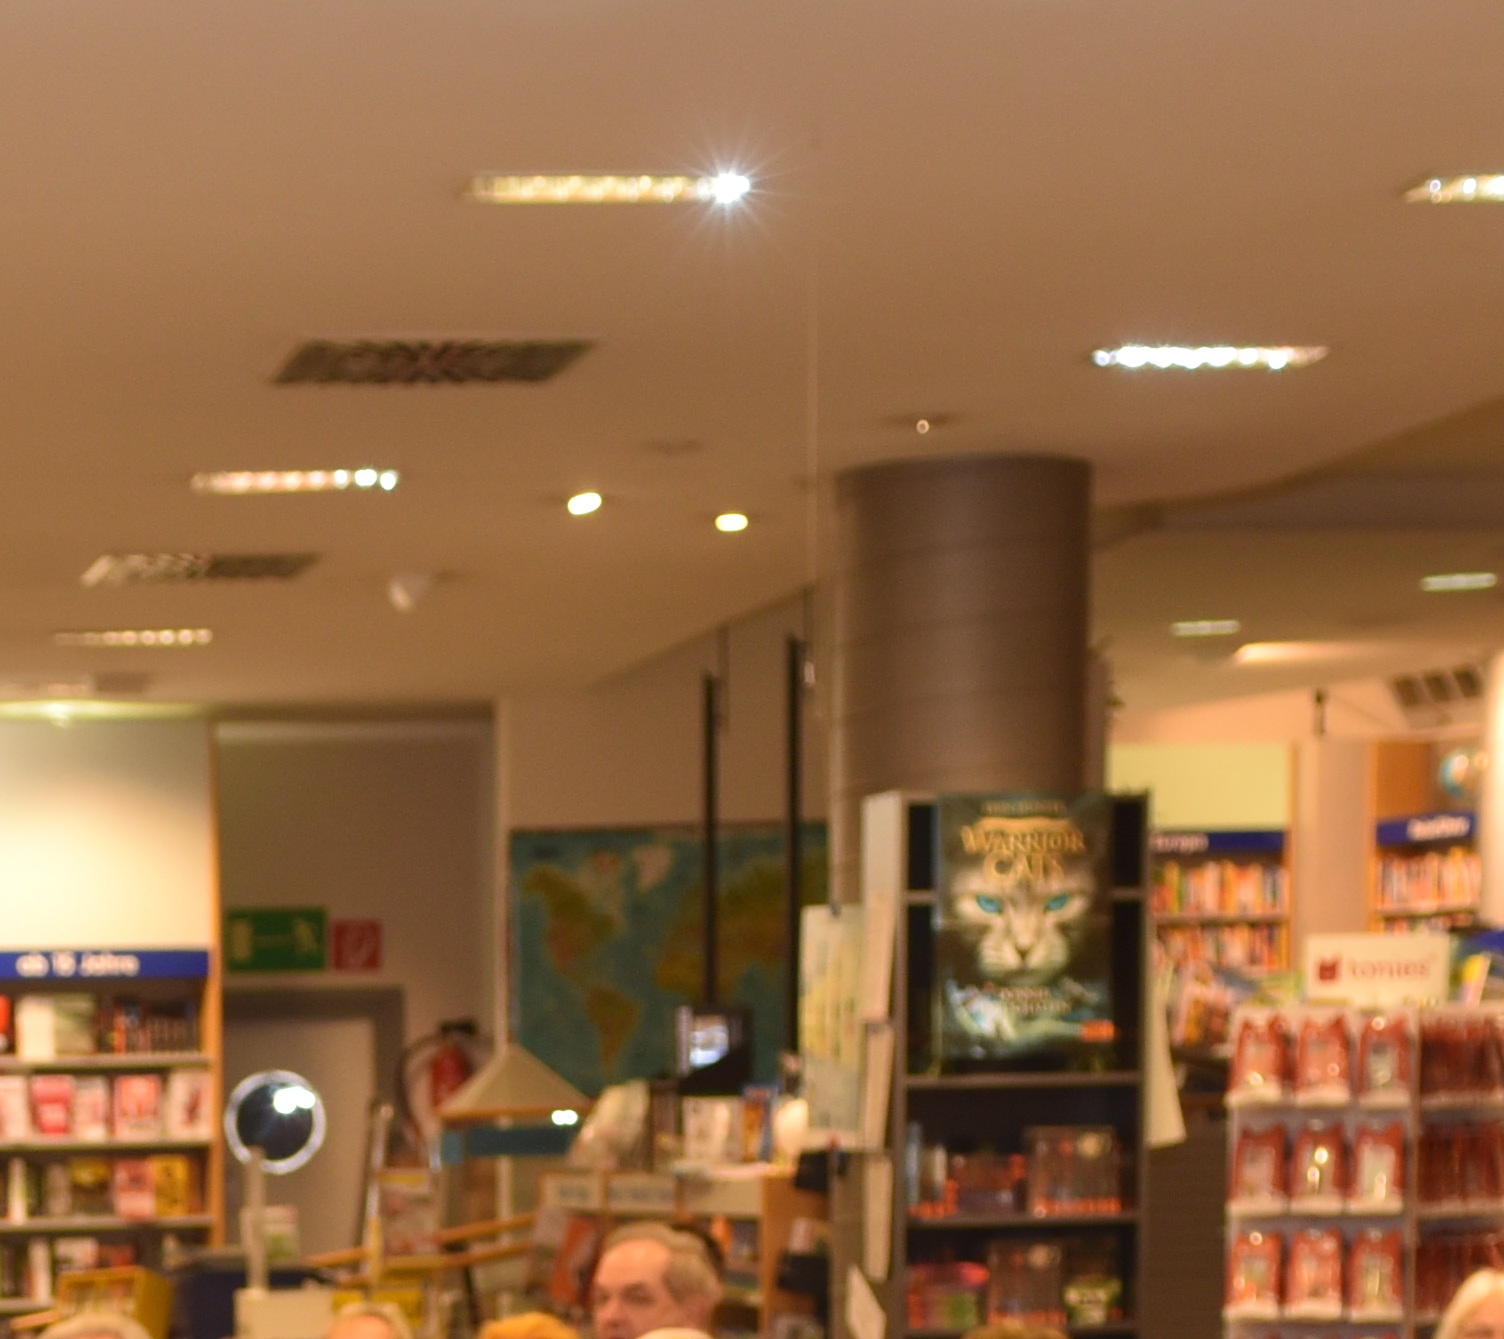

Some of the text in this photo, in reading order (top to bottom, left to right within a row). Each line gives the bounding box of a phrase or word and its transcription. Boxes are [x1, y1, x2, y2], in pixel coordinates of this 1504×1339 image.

[961, 825, 1086, 852] WARRIOR
[984, 850, 1064, 884] CATS
[16, 951, 49, 977] ab
[79, 951, 140, 977] Jahre
[1350, 957, 1430, 981] tonies
